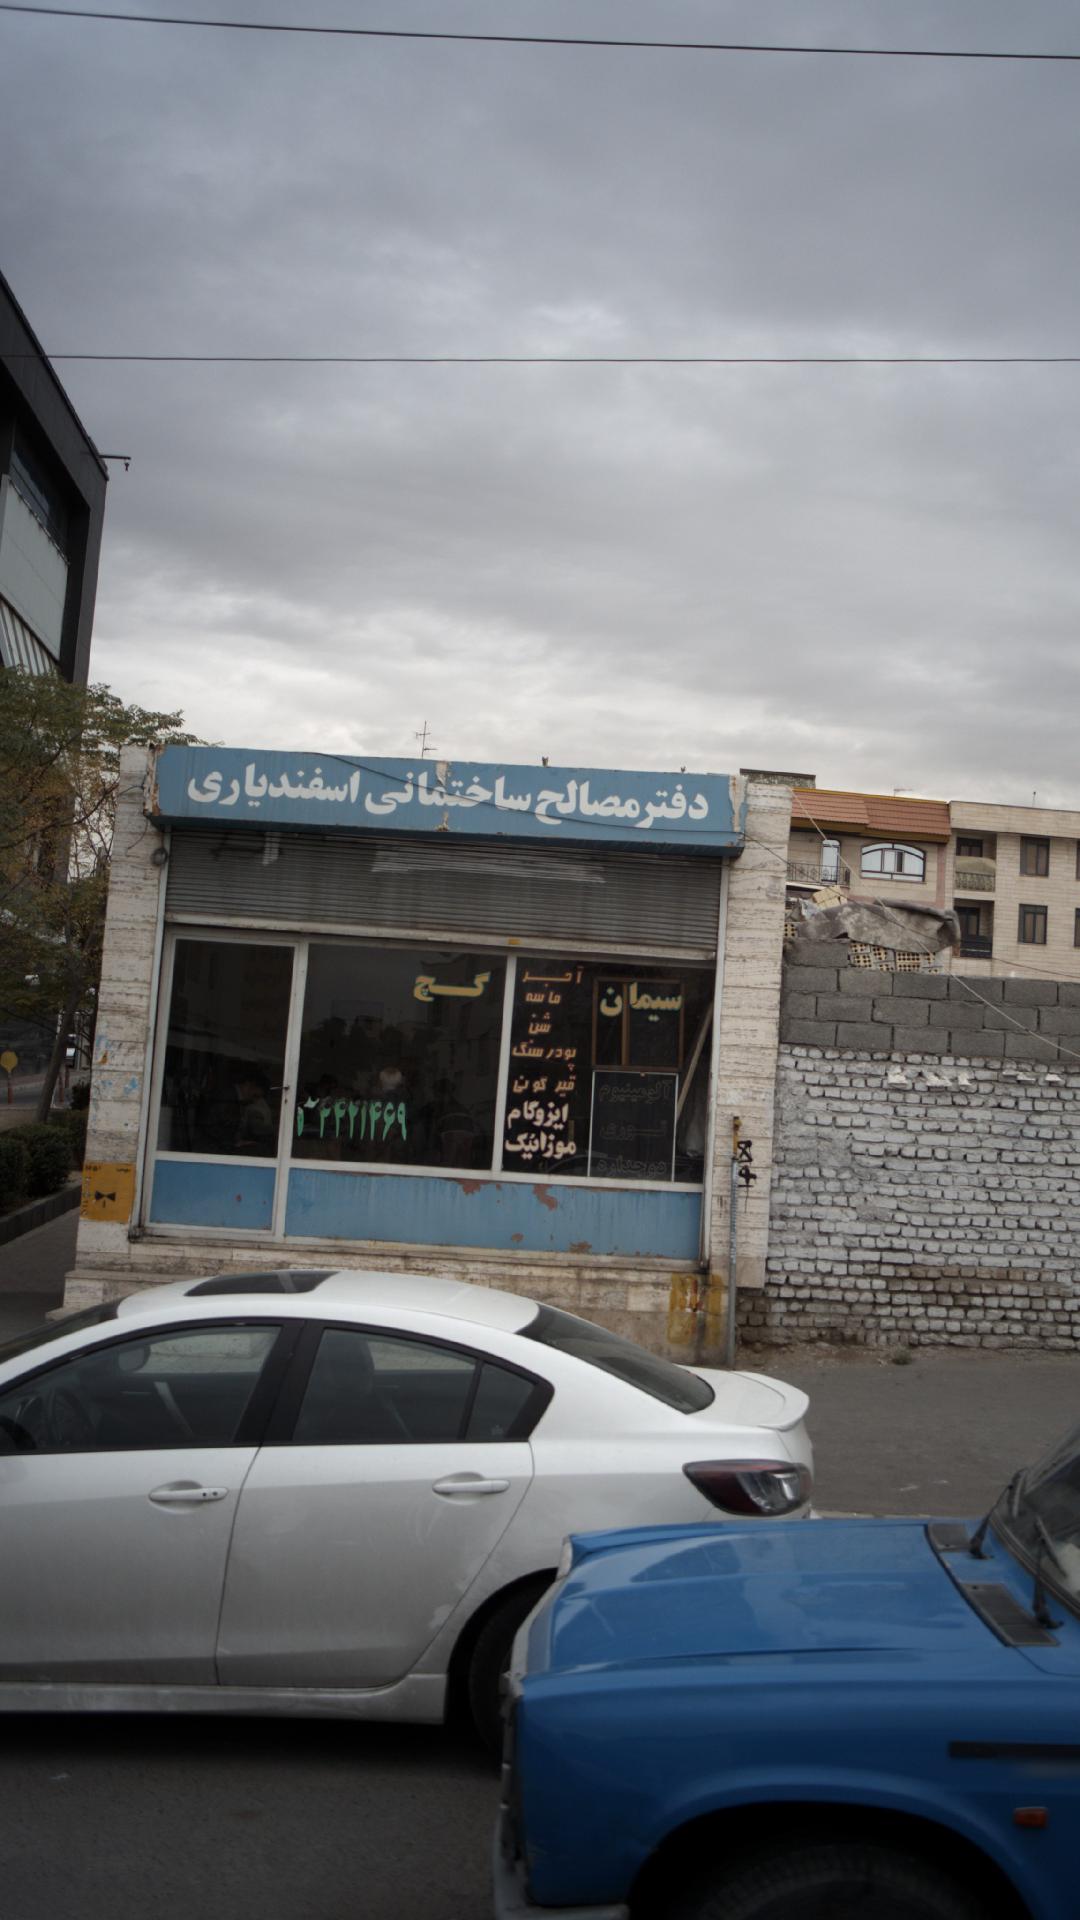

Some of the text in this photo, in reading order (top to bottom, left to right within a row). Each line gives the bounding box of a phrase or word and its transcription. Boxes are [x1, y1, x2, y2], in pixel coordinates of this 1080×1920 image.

[188, 763, 709, 829] دفتر مصالح ساختمانی اسفندیاری
[600, 981, 683, 1022] سیمان
[528, 1011, 552, 1035] شن
[554, 1074, 577, 1098] قیر
[506, 1099, 570, 1130] ایزوگام
